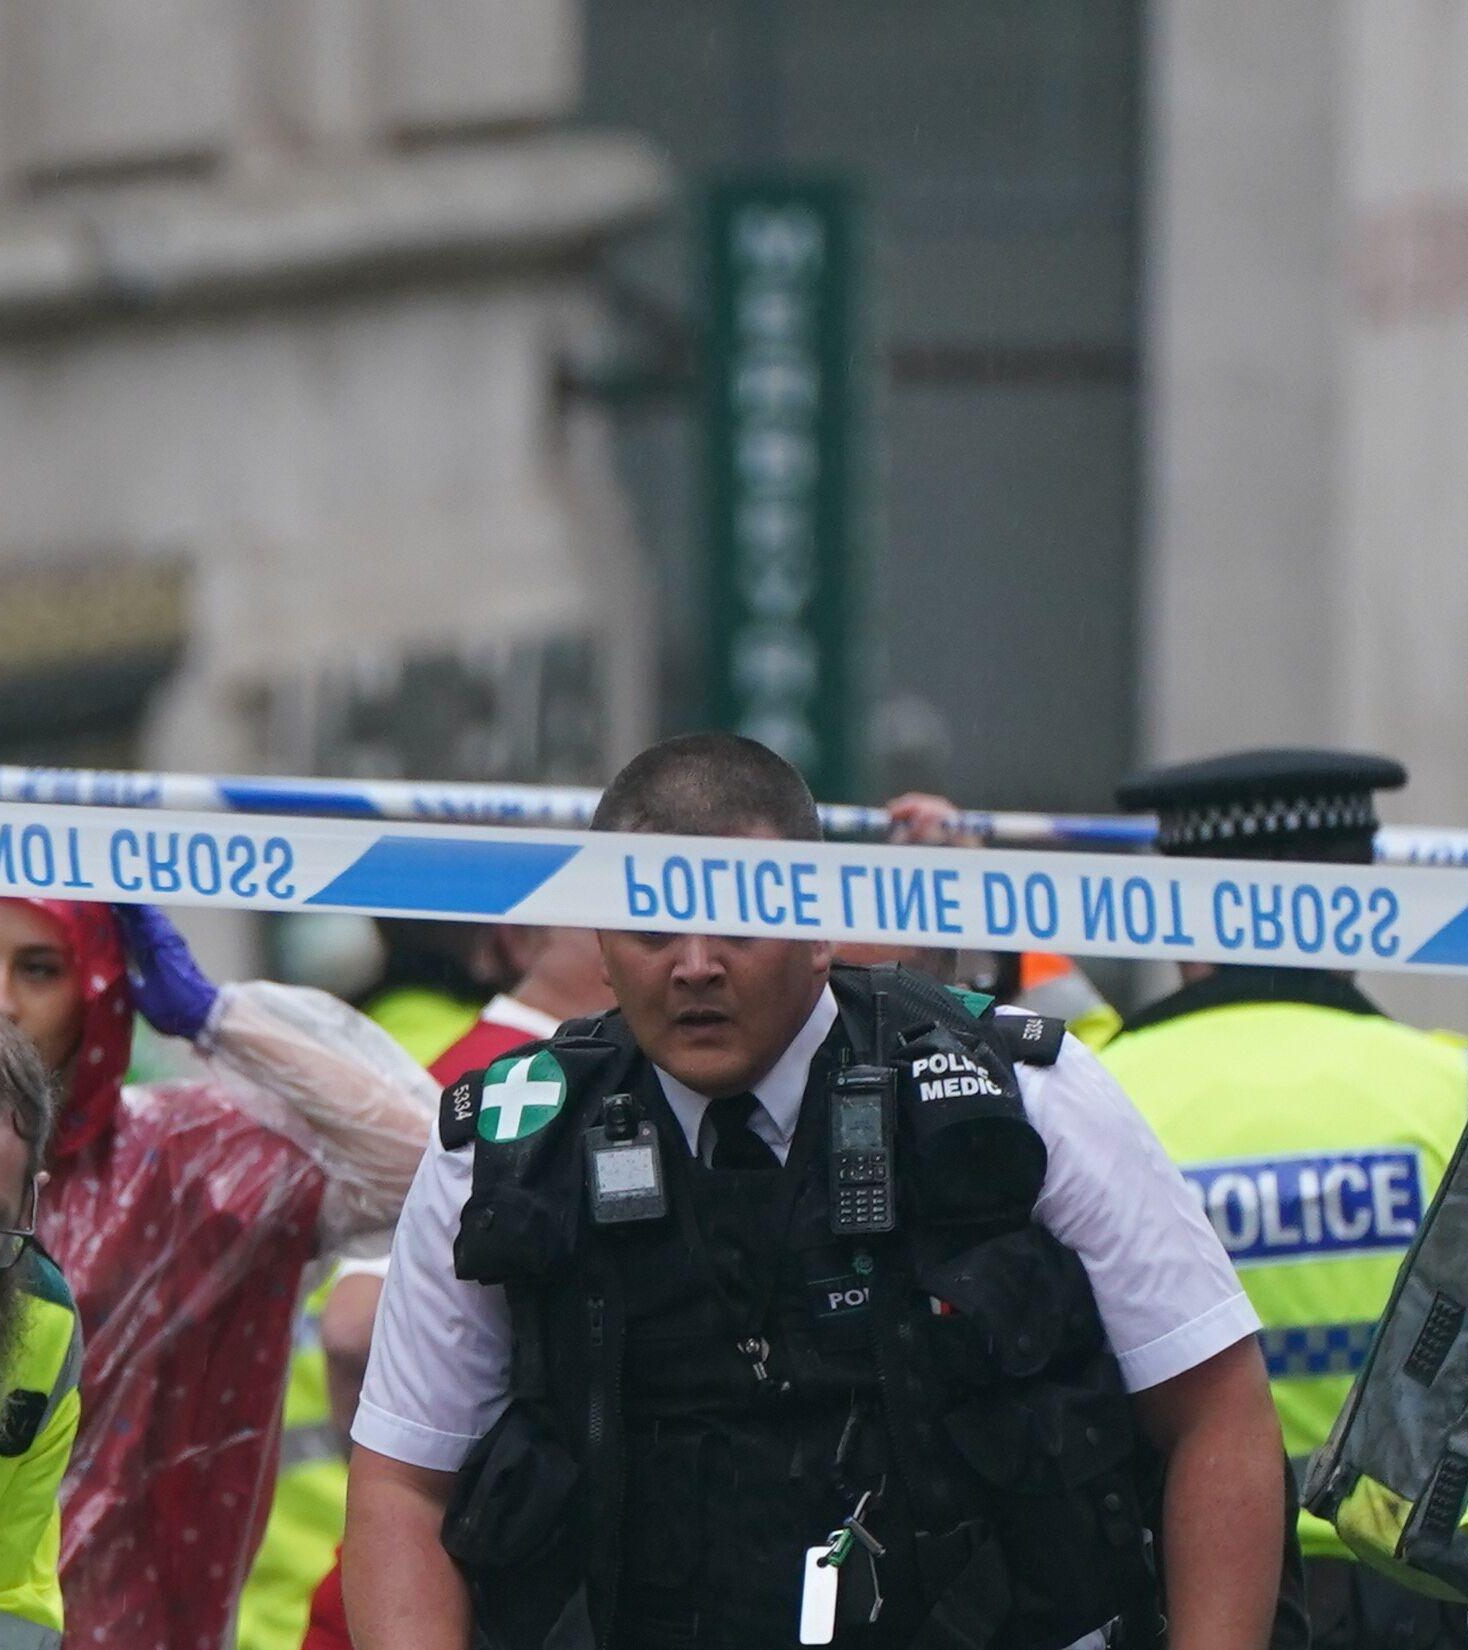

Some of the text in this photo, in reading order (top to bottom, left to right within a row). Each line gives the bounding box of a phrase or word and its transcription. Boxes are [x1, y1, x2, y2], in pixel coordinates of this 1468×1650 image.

[1021, 1017, 1045, 1042] 5334
[919, 1076, 1003, 1102] MEDIC
[452, 1084, 474, 1121] 5334
